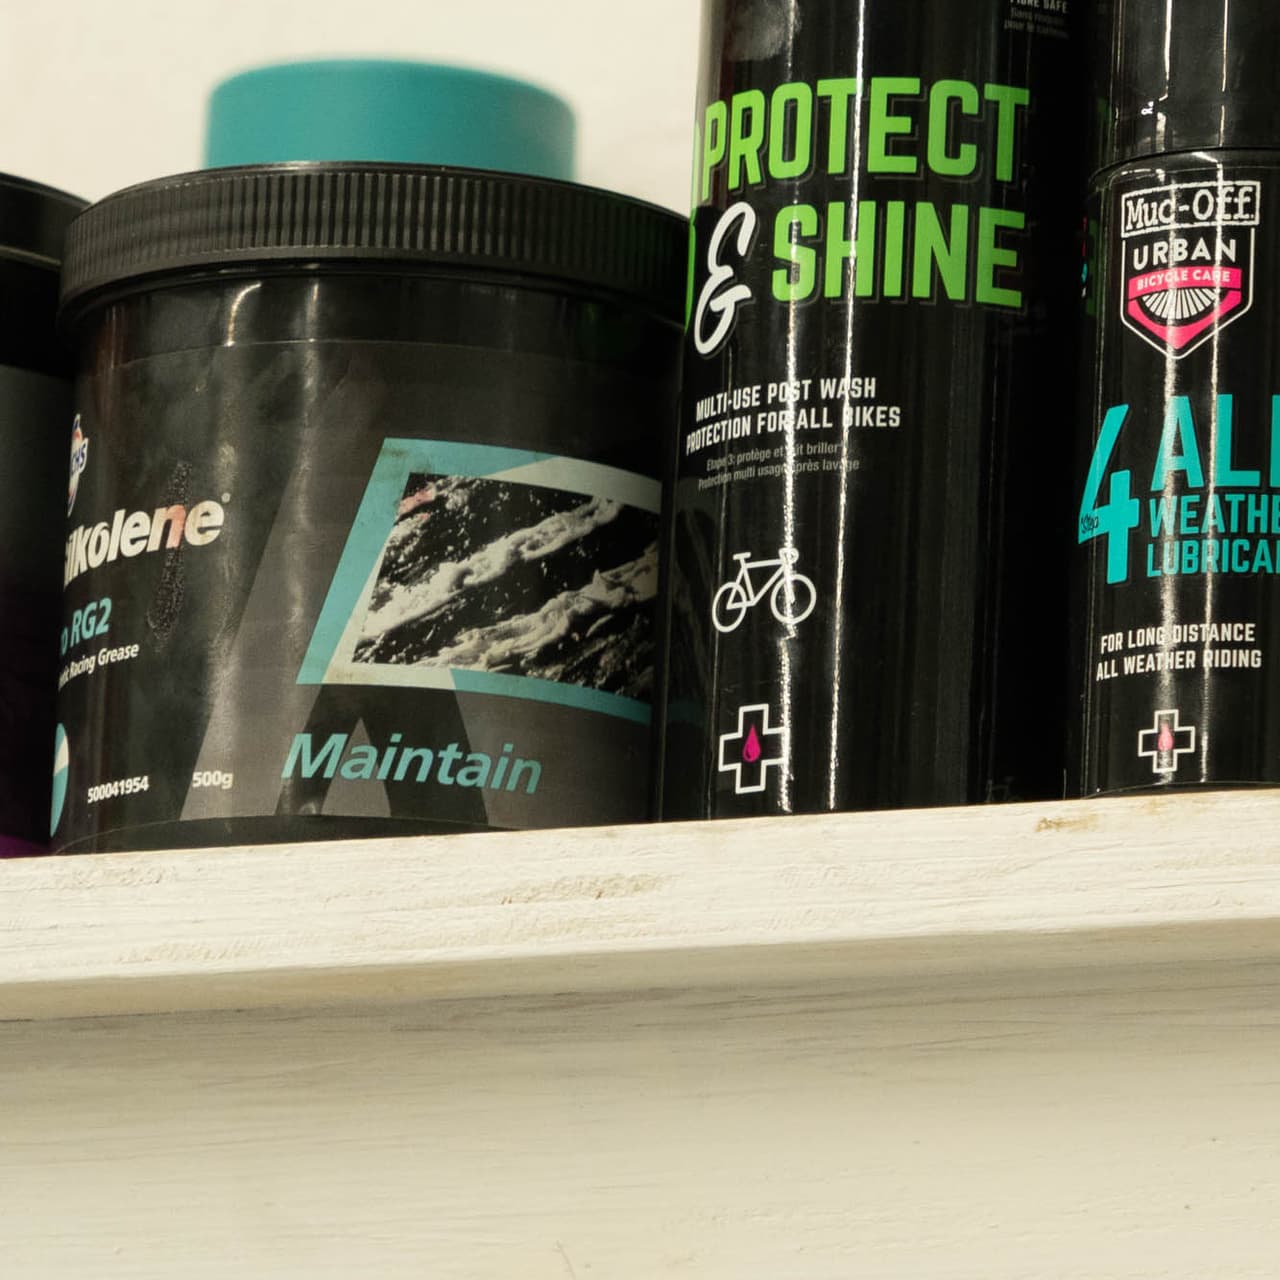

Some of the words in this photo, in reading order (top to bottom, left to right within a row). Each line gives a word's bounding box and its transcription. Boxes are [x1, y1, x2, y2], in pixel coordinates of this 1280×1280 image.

[701, 77, 1030, 204] PROTECT
[1126, 187, 1255, 230] Muc-Off
[1133, 237, 1237, 270] URBAN
[694, 202, 756, 355] &
[771, 201, 1026, 308] SHINE
[1137, 271, 1189, 291] BICYCLE
[1192, 269, 1231, 283] CARE
[696, 385, 761, 422] MULTI-USE
[767, 380, 811, 404] POST
[820, 377, 876, 399] WASH
[686, 414, 751, 456] PROTECTION
[757, 410, 793, 434] FOR
[796, 407, 833, 429] ALL
[842, 406, 901, 428] BIKES
[1078, 404, 1140, 584] 4
[70, 597, 112, 649] RG2
[1101, 632, 1123, 654] FOR
[1128, 626, 1167, 649] LONG
[1172, 623, 1255, 643] DISTANCE
[97, 642, 140, 669] Grease
[1096, 659, 1118, 682] ALL
[1124, 650, 1196, 675] WEATHER
[1203, 649, 1262, 668] RIDING
[192, 770, 234, 790] 500g
[281, 733, 542, 795] Maintain
[87, 775, 150, 804] 500041954
